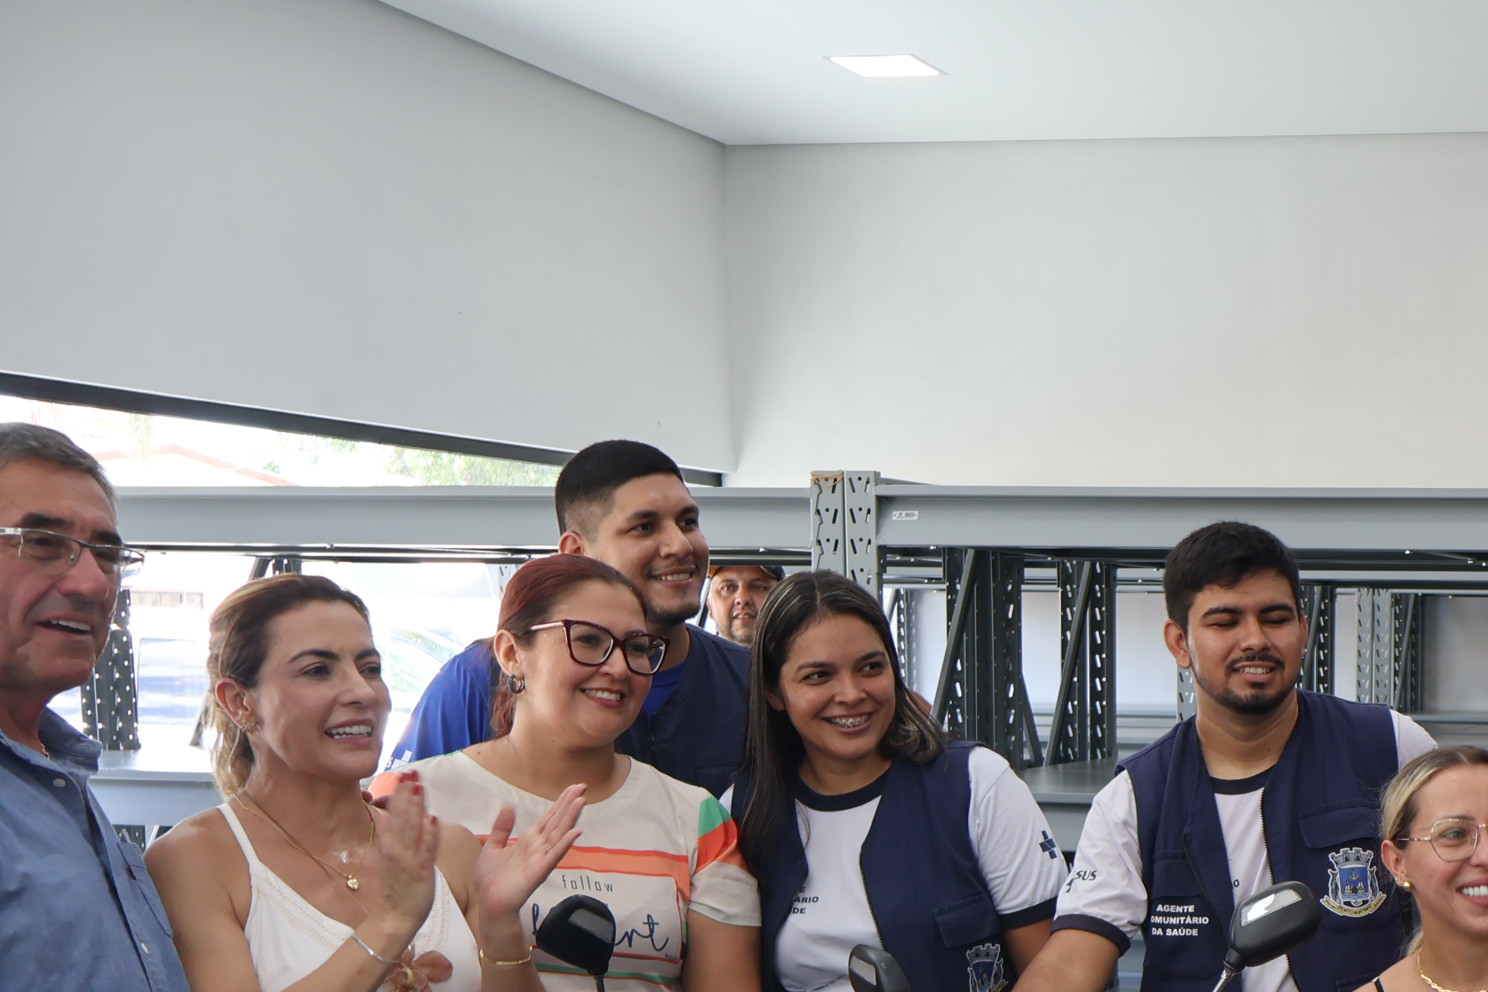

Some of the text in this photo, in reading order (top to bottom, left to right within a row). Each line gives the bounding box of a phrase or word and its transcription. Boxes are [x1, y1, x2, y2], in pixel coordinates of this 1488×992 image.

[1075, 870, 1097, 881] SUS
[562, 874, 614, 893] follow
[1156, 904, 1195, 913] AGENTE
[1150, 915, 1210, 925] OMUNITÁRIO
[1151, 927, 1199, 936] DA SAÚDE
